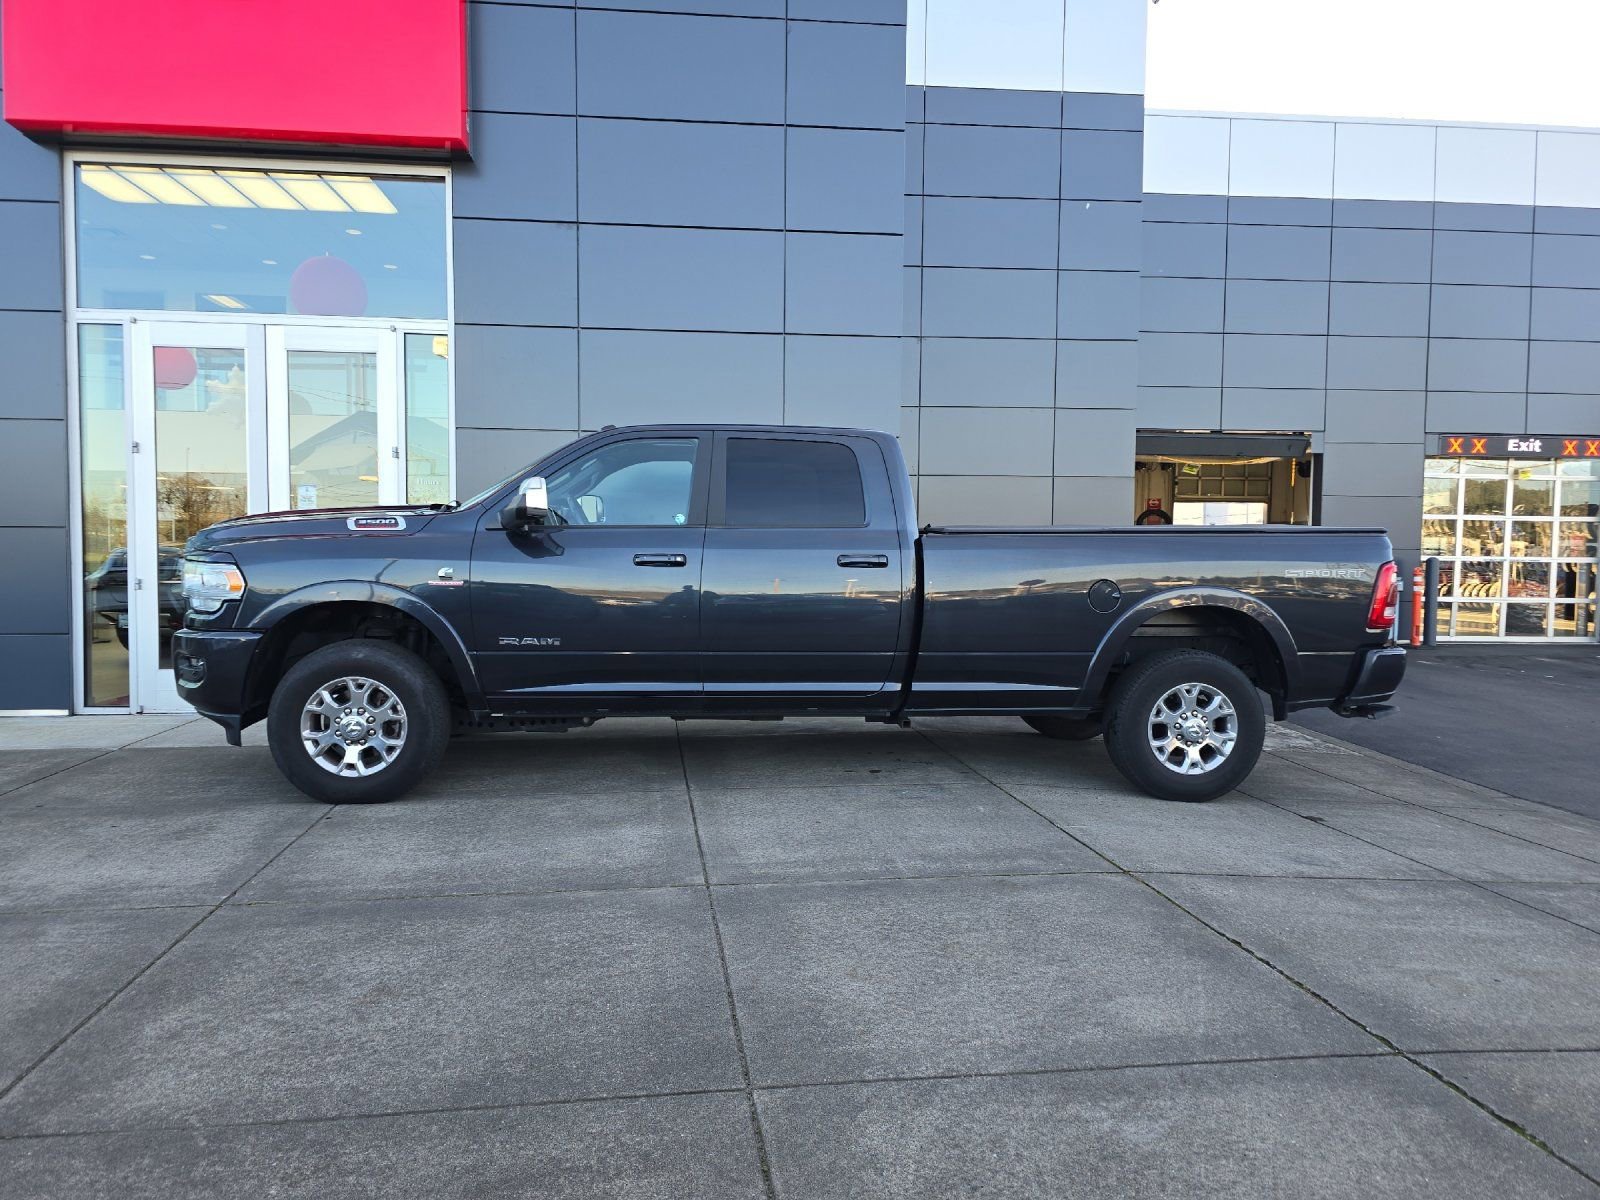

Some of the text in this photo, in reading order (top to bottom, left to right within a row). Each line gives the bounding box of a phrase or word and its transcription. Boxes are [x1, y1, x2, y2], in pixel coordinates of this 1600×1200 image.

[1507, 438, 1542, 452] Exit
[1284, 568, 1366, 578] SPORT
[498, 637, 561, 646] RAM
